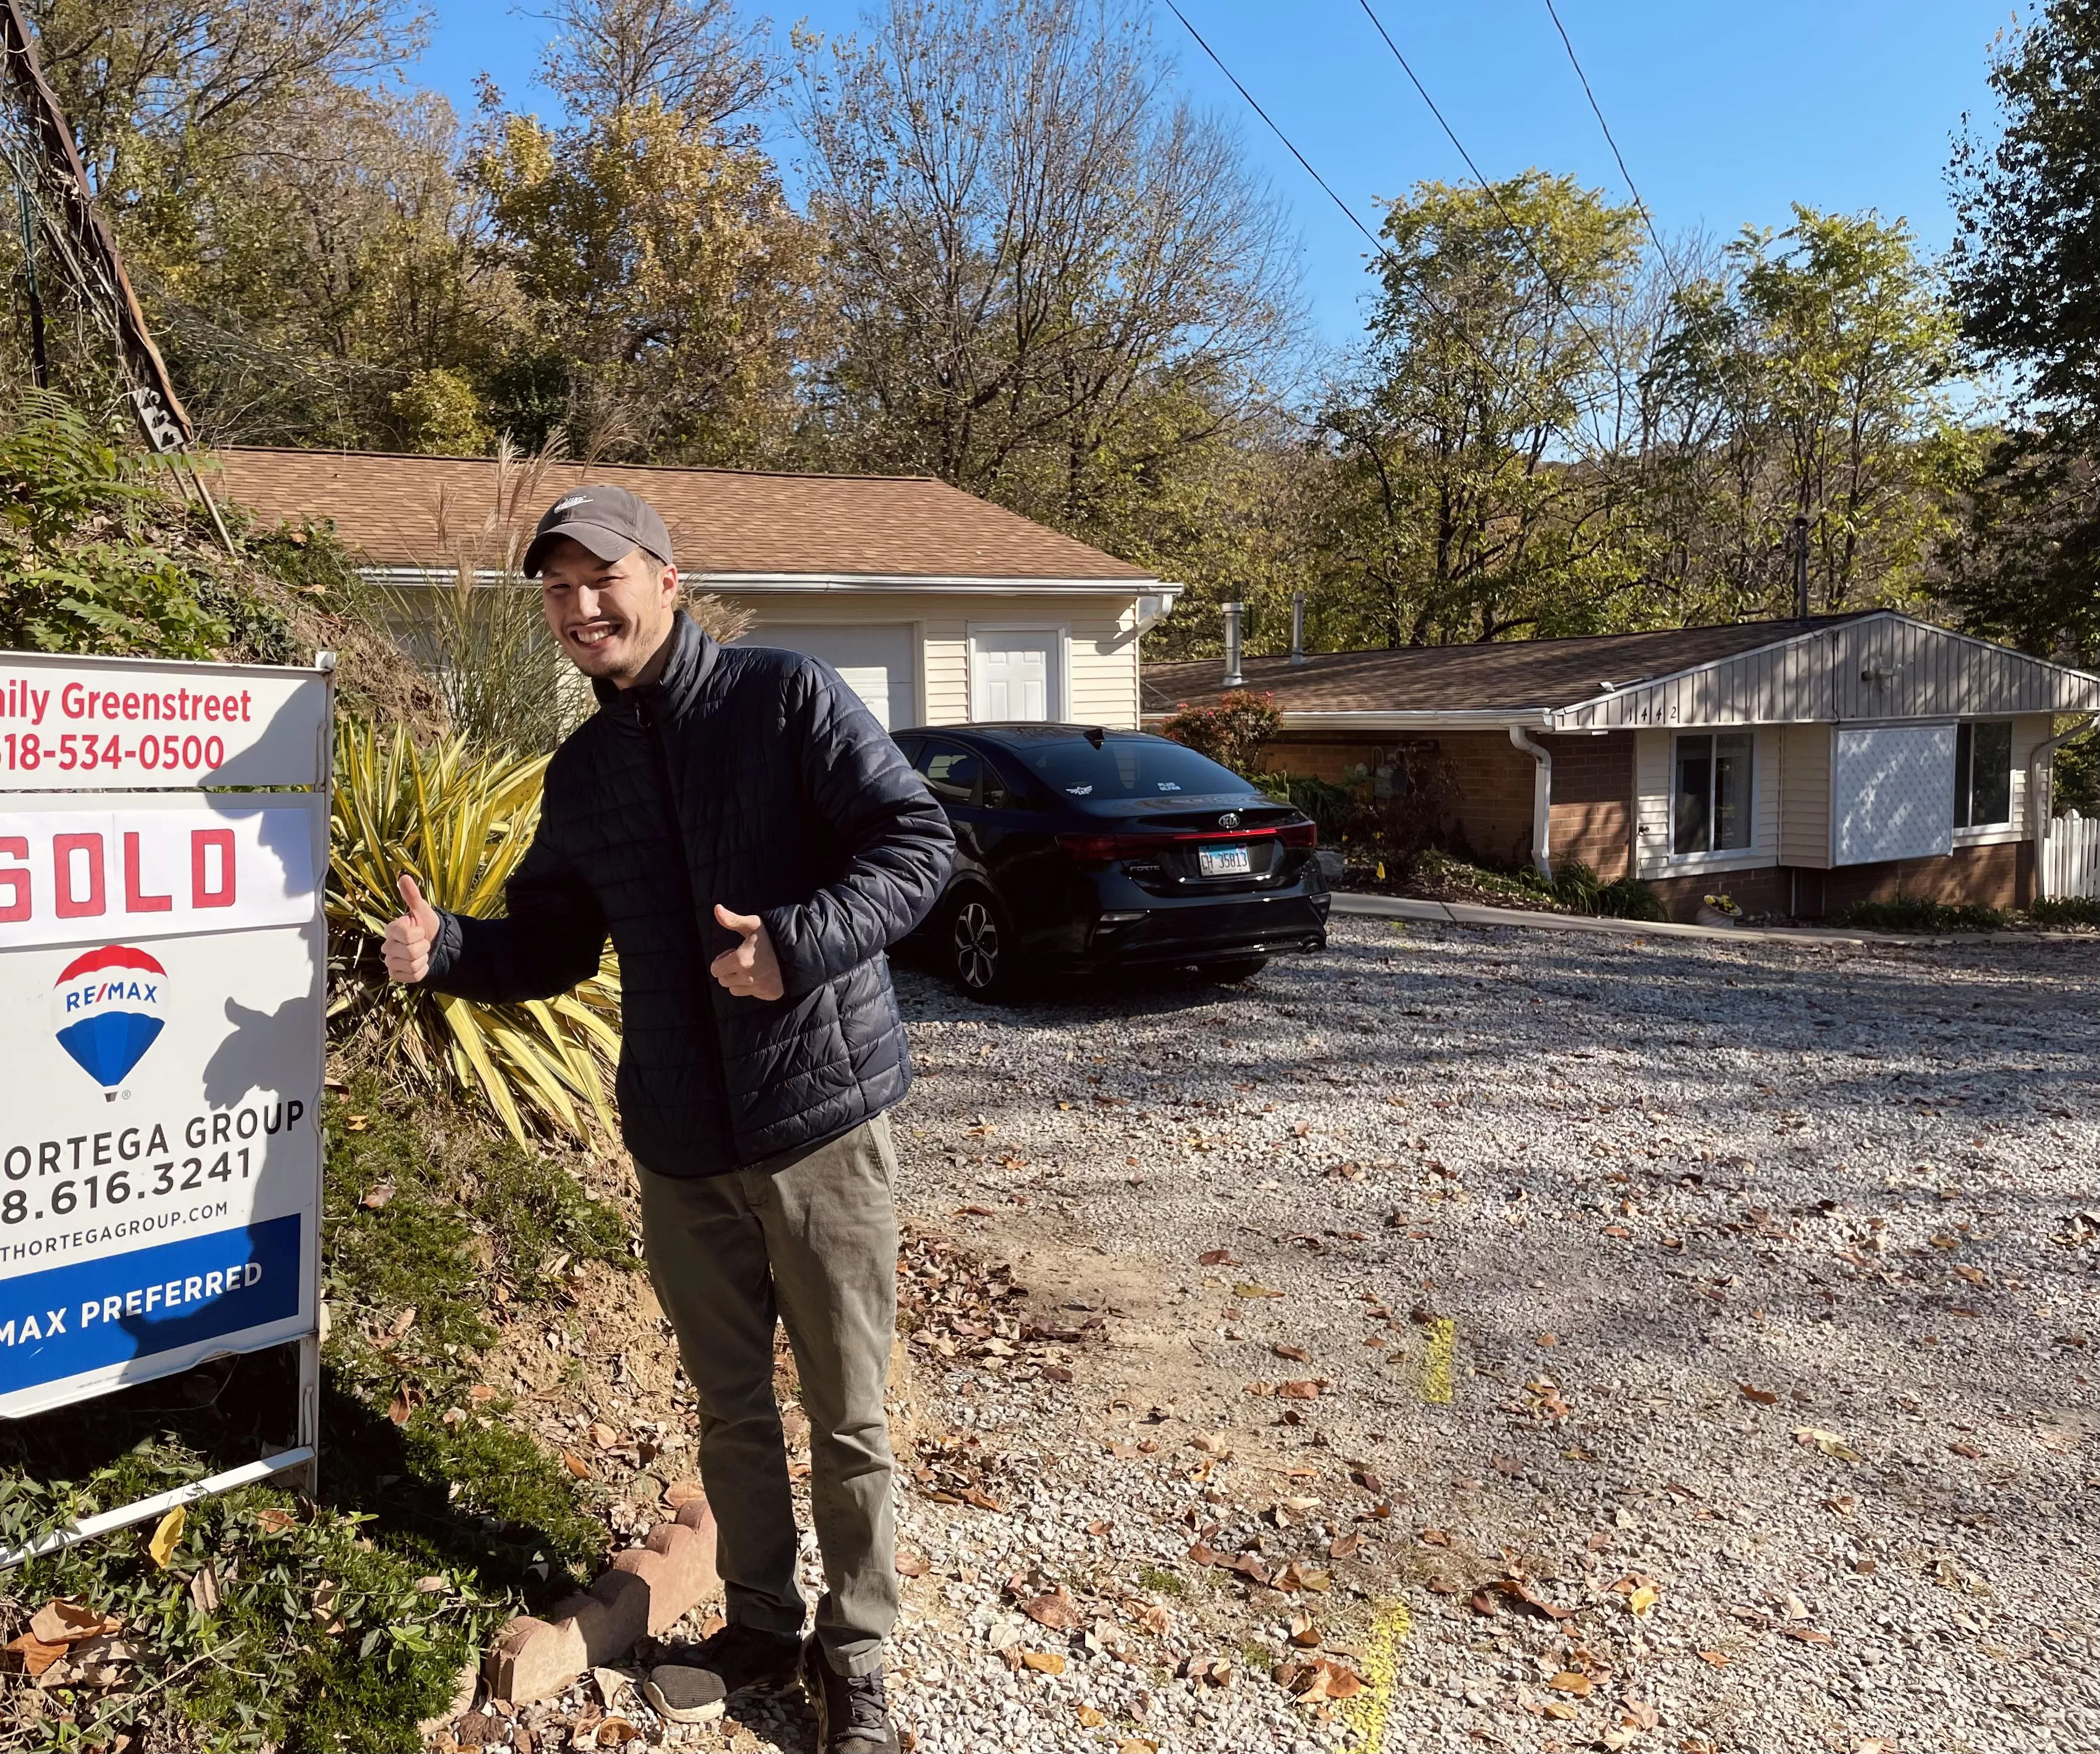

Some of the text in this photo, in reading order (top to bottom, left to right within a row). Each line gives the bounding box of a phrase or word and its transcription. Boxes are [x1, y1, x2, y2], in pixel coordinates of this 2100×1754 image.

[0, 679, 251, 725] ily Greenstreet
[1629, 706, 1677, 722] 1442
[0, 733, 224, 770] 18-534-0500
[0, 828, 235, 923] SOLD
[1201, 852, 1247, 870] CH 35813
[66, 982, 157, 1012] RE/MAX
[3, 1100, 304, 1181] ORTEGA GROUP
[1, 1147, 249, 1224] 8.616.3241
[0, 1201, 228, 1262] THORTEGAGROUP.COM
[0, 1262, 263, 1347] MAX PREFERRED
